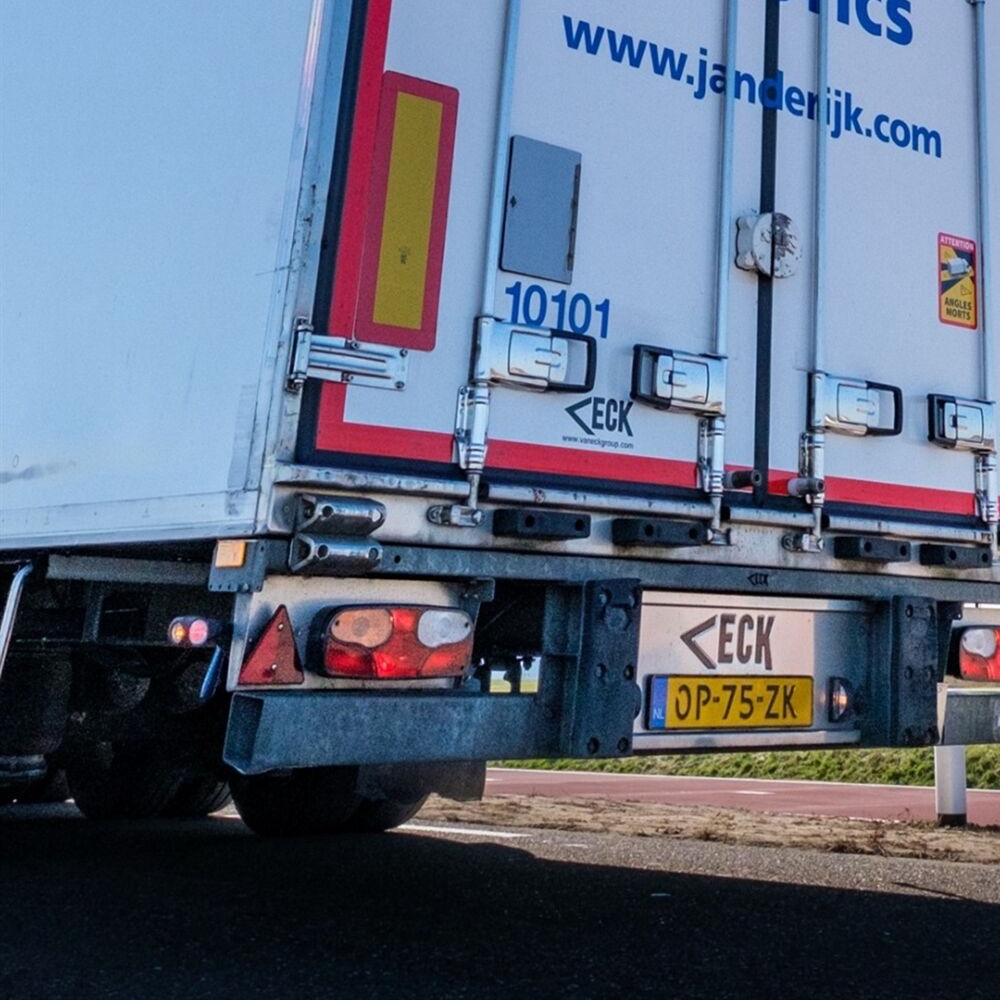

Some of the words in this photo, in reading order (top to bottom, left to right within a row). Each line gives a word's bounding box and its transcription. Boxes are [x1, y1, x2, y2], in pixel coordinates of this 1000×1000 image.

[562, 14, 942, 159] www.janderijk.com
[940, 235, 974, 251] ATTENTION
[505, 281, 610, 339] 10101
[944, 296, 972, 311] ANGLES
[945, 307, 971, 321] MORTS
[562, 435, 634, 449] www.vaneckgroup.com
[653, 707, 665, 721] NL
[674, 683, 798, 721] OP-75-ZK
